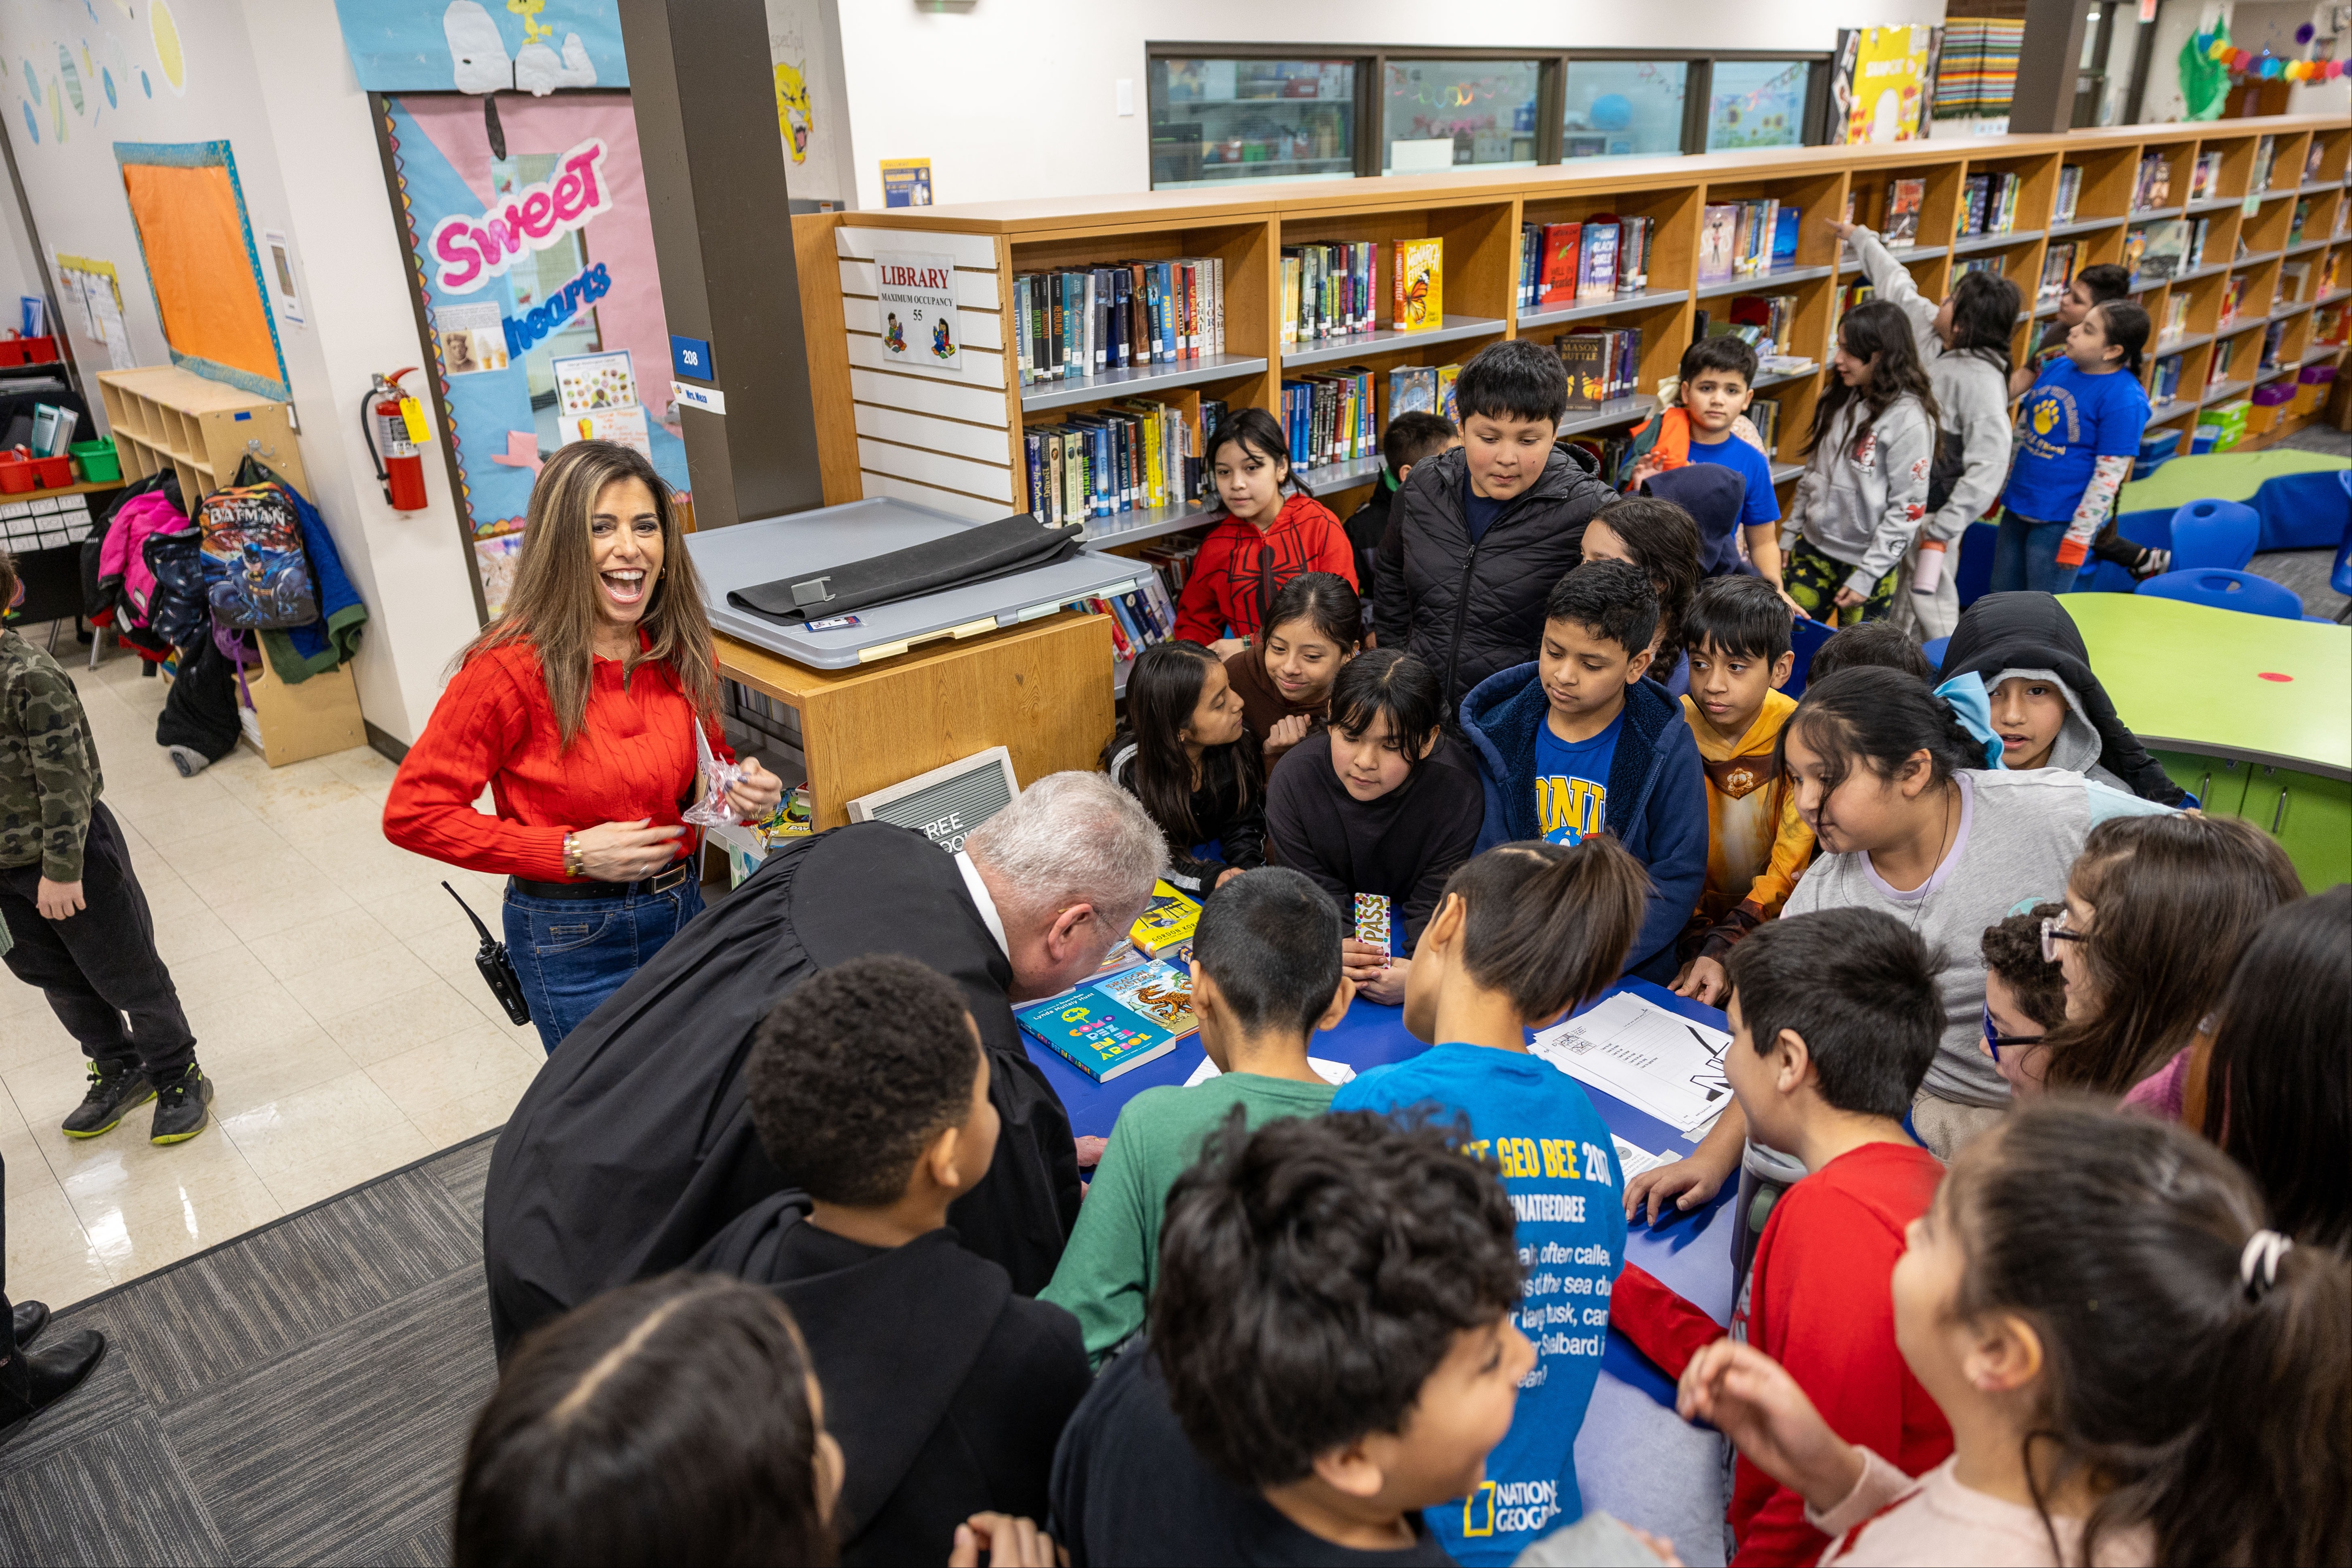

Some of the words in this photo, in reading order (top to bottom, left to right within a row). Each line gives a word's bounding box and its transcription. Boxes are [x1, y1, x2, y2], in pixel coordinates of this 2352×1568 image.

[1592, 241, 1614, 252] BLACK
[1407, 244, 1441, 272] MONARCH
[881, 265, 949, 289] LIBRARY
[881, 293, 913, 303] MAXIMUM
[914, 295, 953, 306] OCCUPANCY
[502, 263, 611, 359] hearts
[913, 309, 922, 321] 55
[1053, 305, 1062, 335] REBOUND
[1163, 296, 1172, 328] POSTED
[1032, 309, 1042, 338] BOOKED
[683, 350, 698, 365] 208
[1561, 353, 1597, 361] BUTTLE
[686, 389, 696, 401] Mrs.
[695, 392, 707, 403] Meza
[1043, 466, 1051, 497] ENDLING
[210, 506, 285, 527] BATMAN
[1362, 898, 1383, 942] PASS
[1152, 928, 1181, 942] GORDON
[1182, 921, 1198, 931] KOR
[1105, 970, 1147, 989] DRAGON
[1114, 973, 1156, 991] MASTERS
[1033, 1010, 1054, 1020] Lynda
[1054, 1000, 1078, 1011] Mullaly
[1078, 992, 1095, 1001] Hunt
[1069, 1015, 1115, 1037] COMO
[1085, 1024, 1120, 1041] PEZ
[1051, 1042, 1060, 1053] PEZ
[1061, 1050, 1068, 1058] EN
[1090, 1037, 1116, 1050] EN
[1113, 1029, 1135, 1040] EL
[1099, 1033, 1152, 1061] ÁRBOL
[1496, 1137, 1540, 1178] GEO
[1540, 1138, 1580, 1179] BEE
[1574, 1243, 1611, 1267] calle
[1563, 1276, 1593, 1294] sea
[1546, 1301, 1578, 1327] tusk,
[1496, 1480, 1557, 1507] NATION
